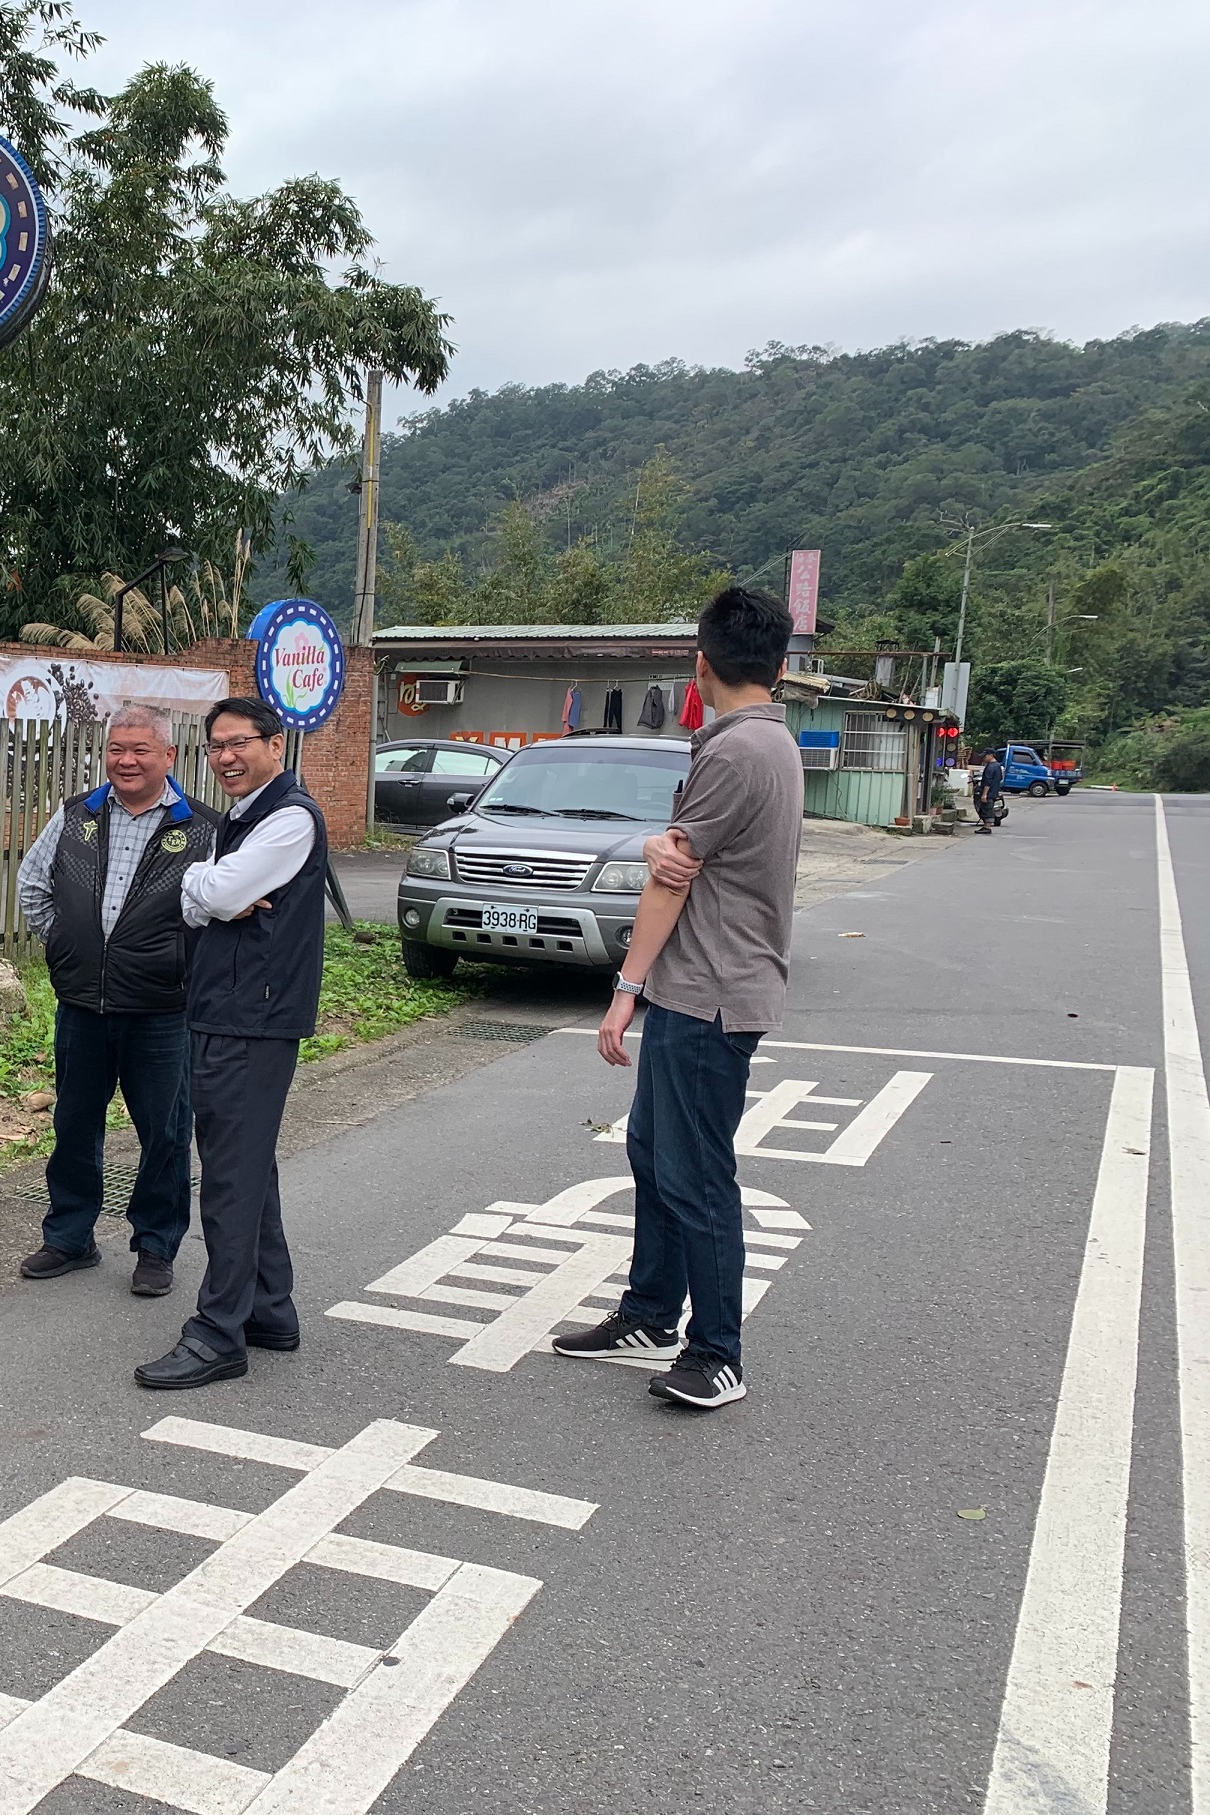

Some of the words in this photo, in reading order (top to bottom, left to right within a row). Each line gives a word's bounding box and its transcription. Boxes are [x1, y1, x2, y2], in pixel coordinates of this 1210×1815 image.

[274, 645, 325, 668] Vanilla
[292, 667, 324, 692] Cafe
[482, 910, 537, 930] 3938-RG
